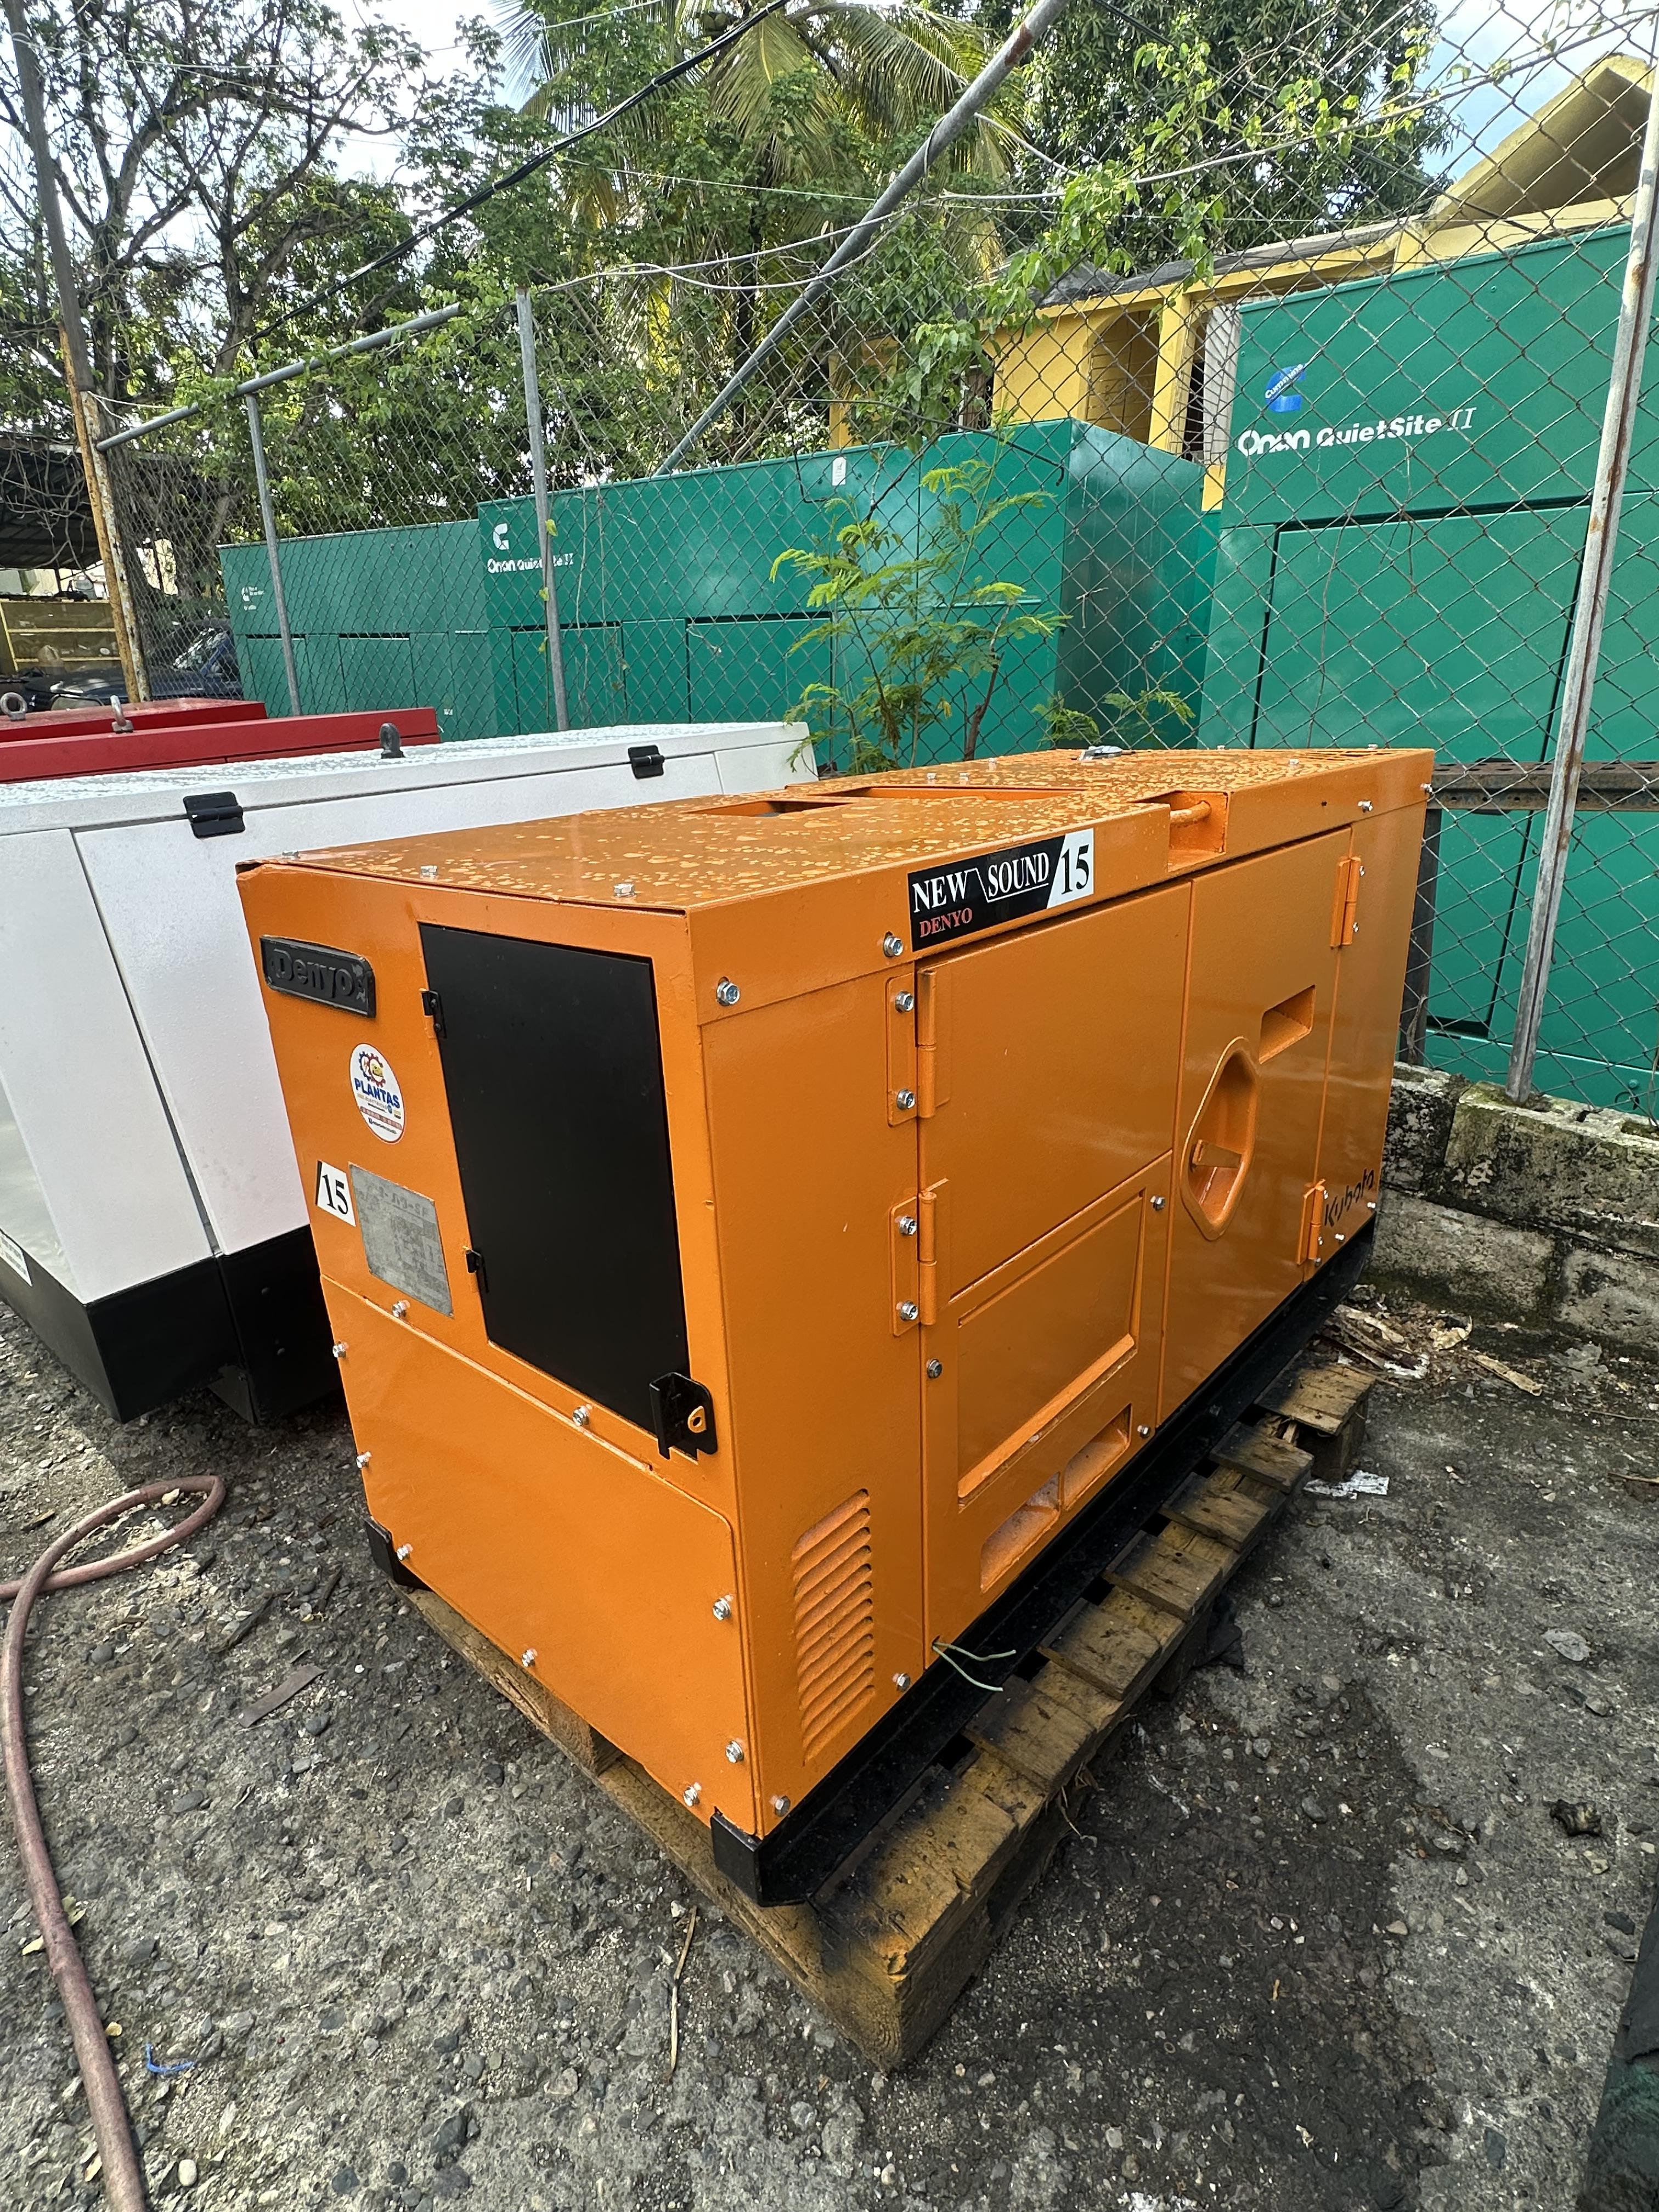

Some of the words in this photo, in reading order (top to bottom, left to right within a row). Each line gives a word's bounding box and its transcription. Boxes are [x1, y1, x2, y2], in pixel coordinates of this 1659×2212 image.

[1238, 430, 1311, 456] Onan
[1317, 415, 1442, 447] QuietSite
[1447, 407, 1477, 431] II
[487, 558, 516, 574] Onan
[517, 555, 562, 570] Quiette
[912, 870, 969, 913] NEW
[988, 852, 1050, 898] SOUND
[1061, 844, 1090, 895] 15
[919, 908, 973, 938] DENYO
[273, 948, 354, 998] Denyo
[354, 1077, 400, 1109] PLANTAS
[321, 1174, 349, 1215] 15
[1324, 1169, 1374, 1228] Kubota
